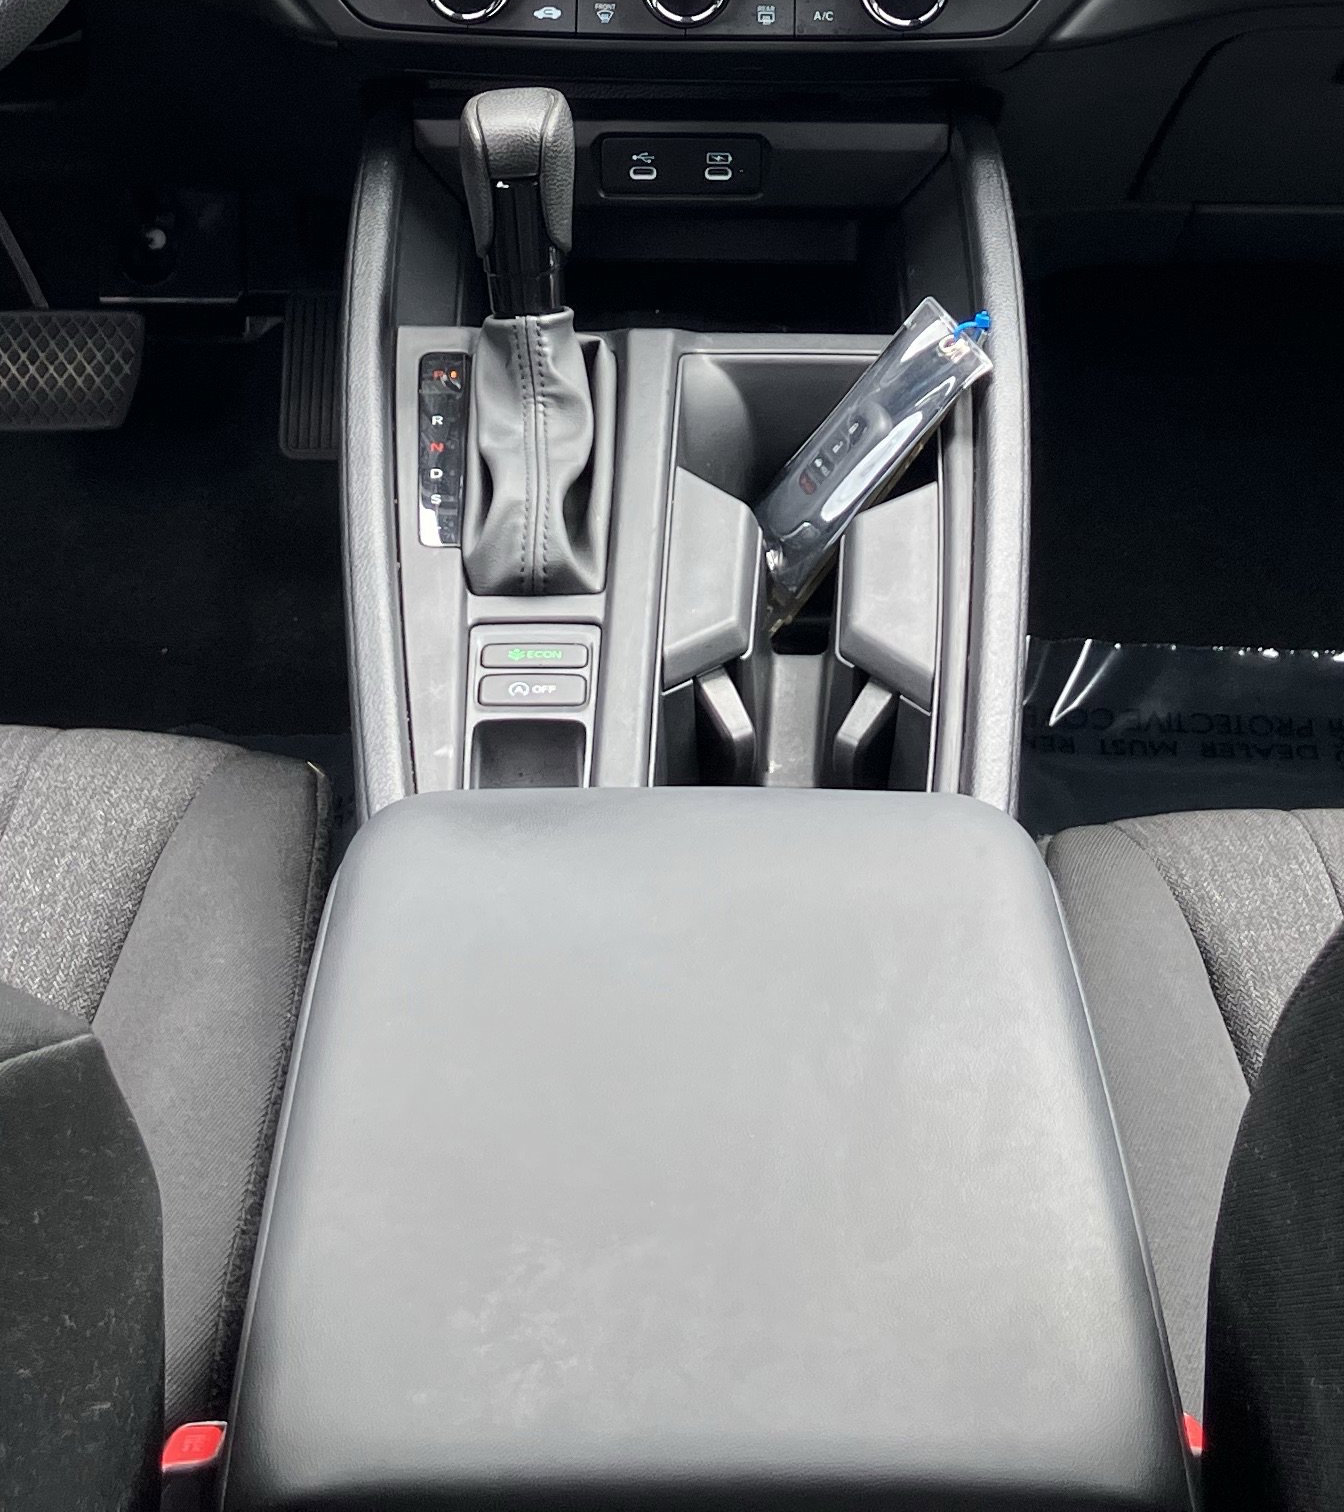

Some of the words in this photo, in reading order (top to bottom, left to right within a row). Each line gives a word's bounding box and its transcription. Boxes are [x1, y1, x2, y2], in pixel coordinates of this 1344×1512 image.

[813, 10, 834, 22] A/C
[432, 415, 443, 426] R
[430, 442, 444, 452] N
[430, 468, 443, 479] D
[430, 494, 442, 505] S
[526, 649, 562, 659] ECON
[531, 684, 557, 694] OFF
[1098, 738, 1178, 758] MUST
[1200, 742, 1319, 761] DEALER
